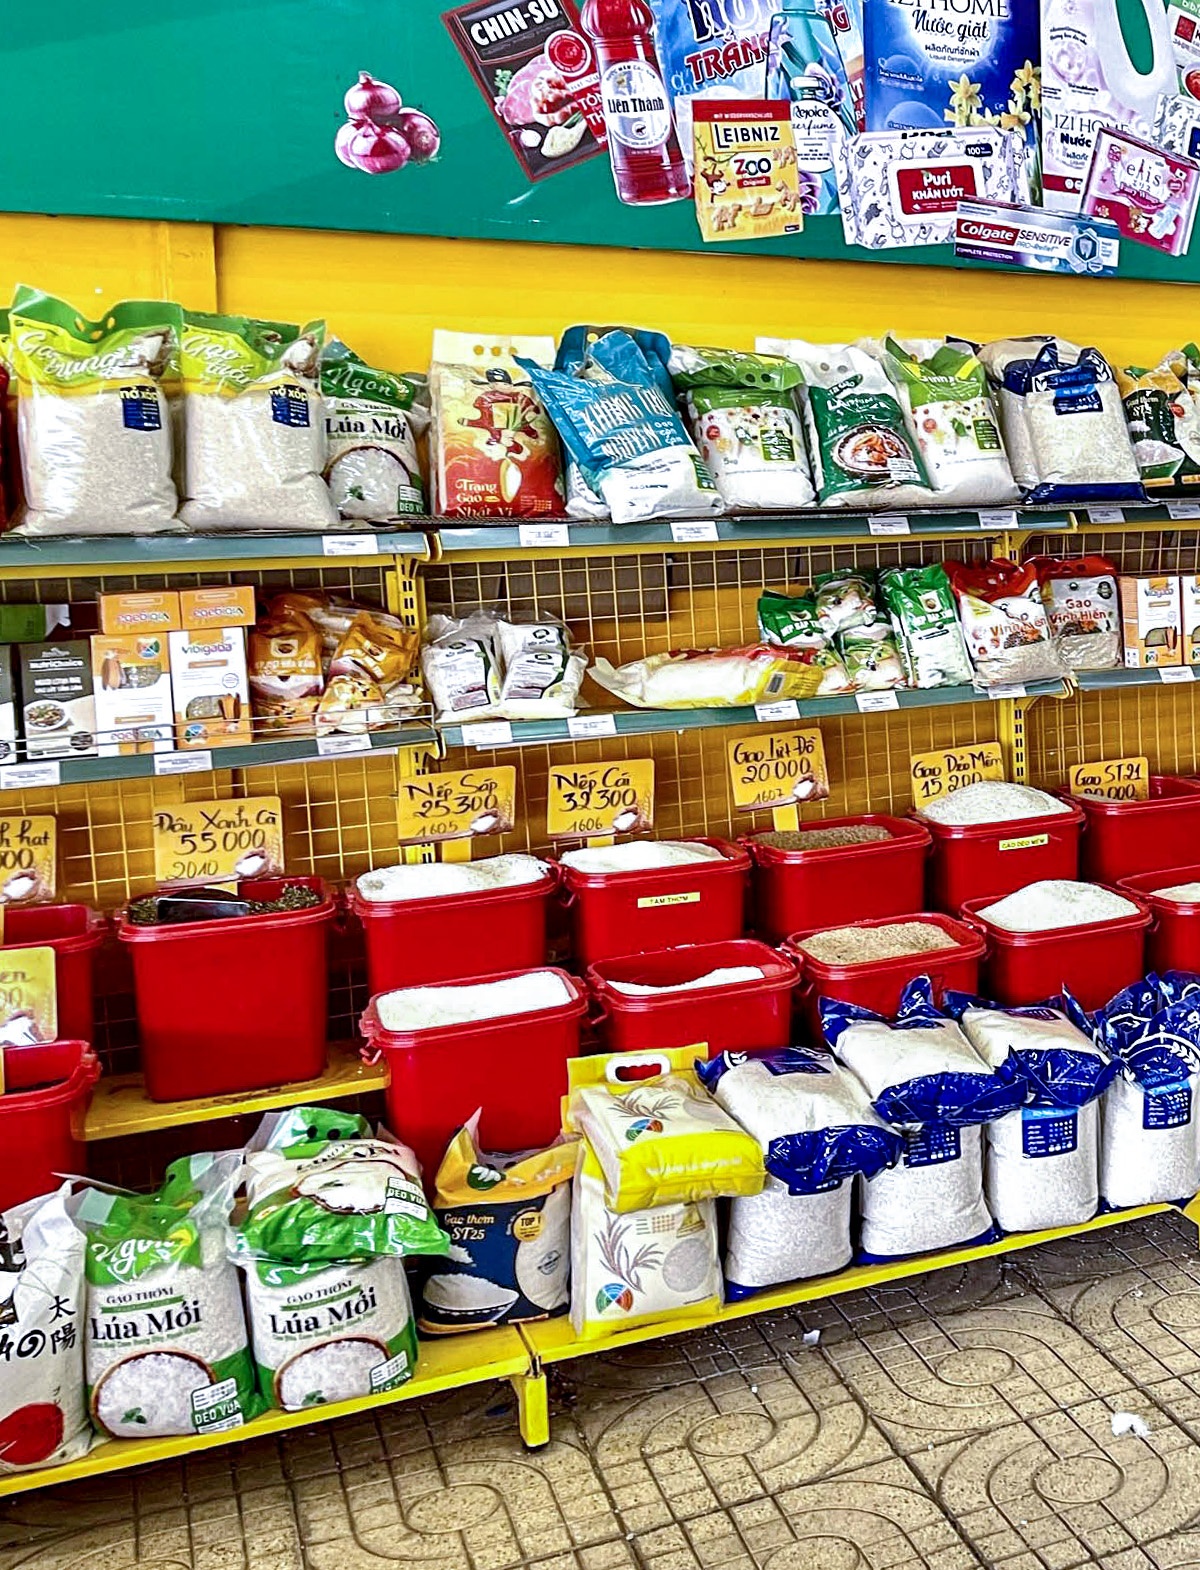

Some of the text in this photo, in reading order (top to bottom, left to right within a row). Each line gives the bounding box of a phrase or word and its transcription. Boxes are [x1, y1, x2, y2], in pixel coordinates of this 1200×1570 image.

[470, 0, 561, 46] CHIN-SU
[912, 9, 990, 42] Nước giặt
[607, 98, 629, 113] Liên
[1054, 114, 1075, 131] IZI
[714, 124, 780, 148] LEIBNIZ
[1060, 131, 1092, 147] Nước
[734, 158, 771, 176] ZOO
[1126, 159, 1162, 187] elis
[923, 170, 952, 187] Puri
[912, 186, 964, 201] KHĂN ƯỚT
[960, 222, 1072, 246] Colgate SENSITIVE
[327, 368, 393, 397] Ngon
[325, 412, 365, 434] Lúa
[181, 642, 233, 656] vibigaba
[551, 766, 631, 793] Nếp Cái
[1103, 763, 1143, 784] ST21
[403, 773, 498, 801] Nếp Sáp
[199, 805, 252, 831] Xanh
[566, 818, 603, 833] 1606
[165, 860, 219, 881] 2010
[520, 1216, 535, 1227] TOP
[452, 1226, 486, 1241] ST25
[90, 1316, 140, 1341] Lúa
[147, 1299, 203, 1335] Mới
[268, 1312, 320, 1335] Lúa
[327, 1286, 378, 1326] Mới
[49, 1295, 77, 1355] 太陽
